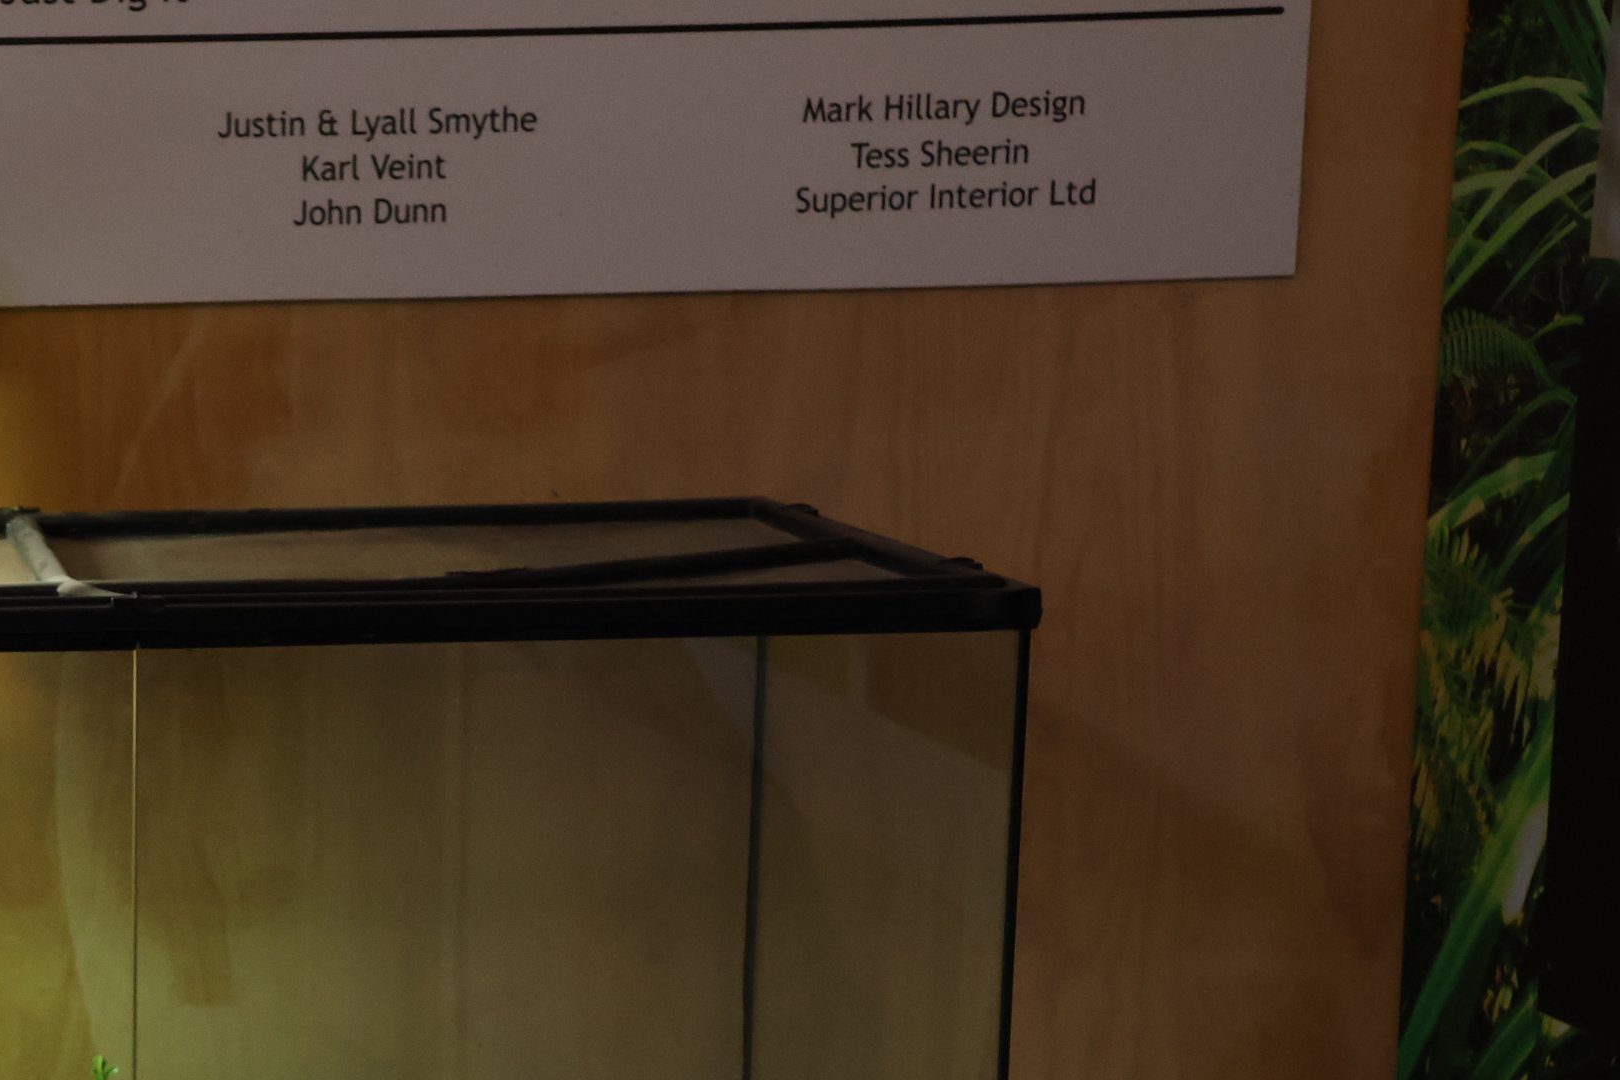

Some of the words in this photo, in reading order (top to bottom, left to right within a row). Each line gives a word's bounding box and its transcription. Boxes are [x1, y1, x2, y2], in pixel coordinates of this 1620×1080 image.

[217, 110, 306, 138] Justin
[318, 109, 339, 136] &
[351, 107, 417, 142] Lyall
[429, 105, 538, 140] Smythe
[802, 94, 874, 123] Mark
[884, 93, 980, 126] Hillary
[991, 89, 1086, 123] Design
[302, 153, 360, 182] Karl
[371, 153, 447, 181] Veint
[851, 141, 910, 169] Tess
[920, 138, 1030, 167] Sheerin
[293, 198, 362, 226] John
[373, 198, 448, 224] Dunn
[795, 184, 919, 219] Superior
[929, 181, 1039, 210] Interior
[1049, 177, 1097, 206] Ltd
